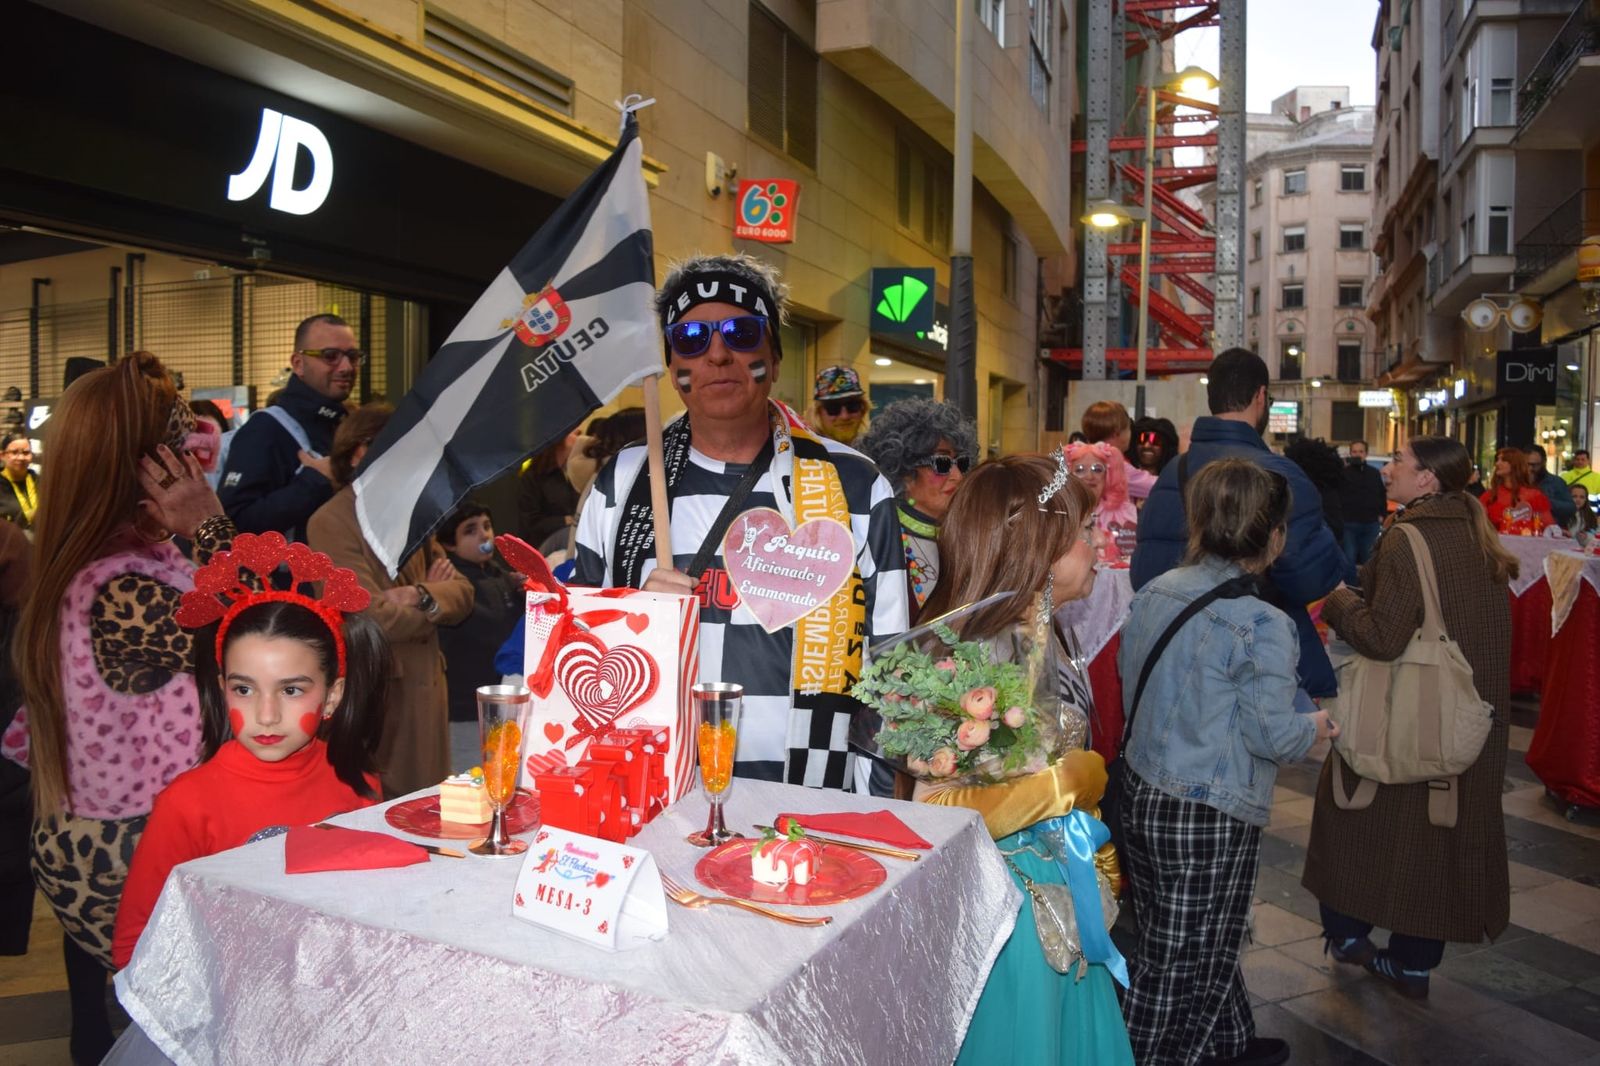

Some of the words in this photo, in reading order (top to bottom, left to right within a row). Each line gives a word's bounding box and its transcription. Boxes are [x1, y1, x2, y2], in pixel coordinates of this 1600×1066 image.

[227, 107, 333, 215] JD
[736, 226, 760, 236] EURO
[762, 227, 787, 238] 6000
[763, 534, 841, 562] Paquito
[741, 555, 815, 582] Aficionado
[816, 575, 826, 587] y
[740, 579, 818, 607] Enamorado
[535, 883, 592, 916] MESA-3
